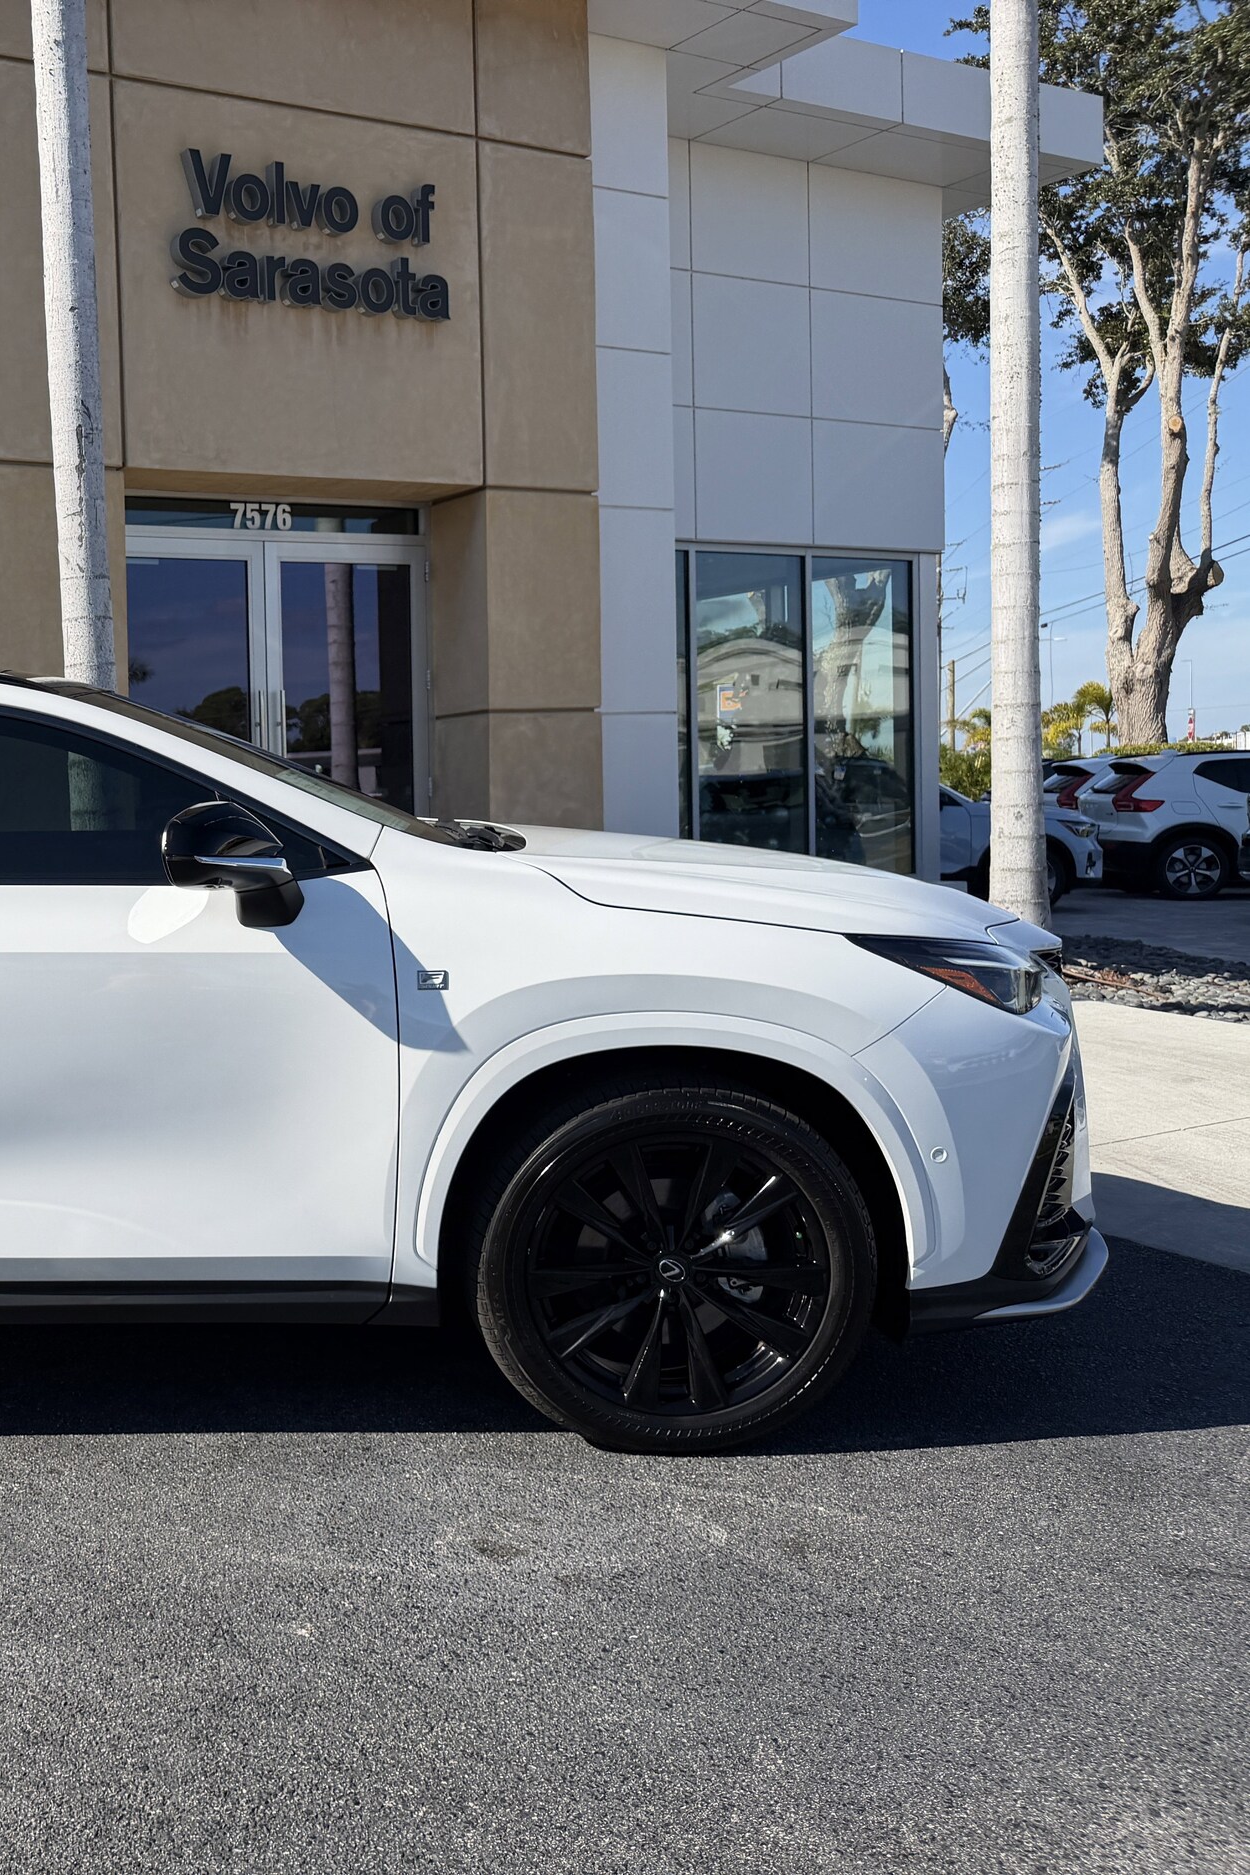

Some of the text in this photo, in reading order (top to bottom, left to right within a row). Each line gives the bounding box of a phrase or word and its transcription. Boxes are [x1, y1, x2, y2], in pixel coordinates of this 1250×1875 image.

[180, 148, 436, 247] Volvo of
[170, 227, 451, 322] Sarasota
[230, 502, 292, 531] 7576
